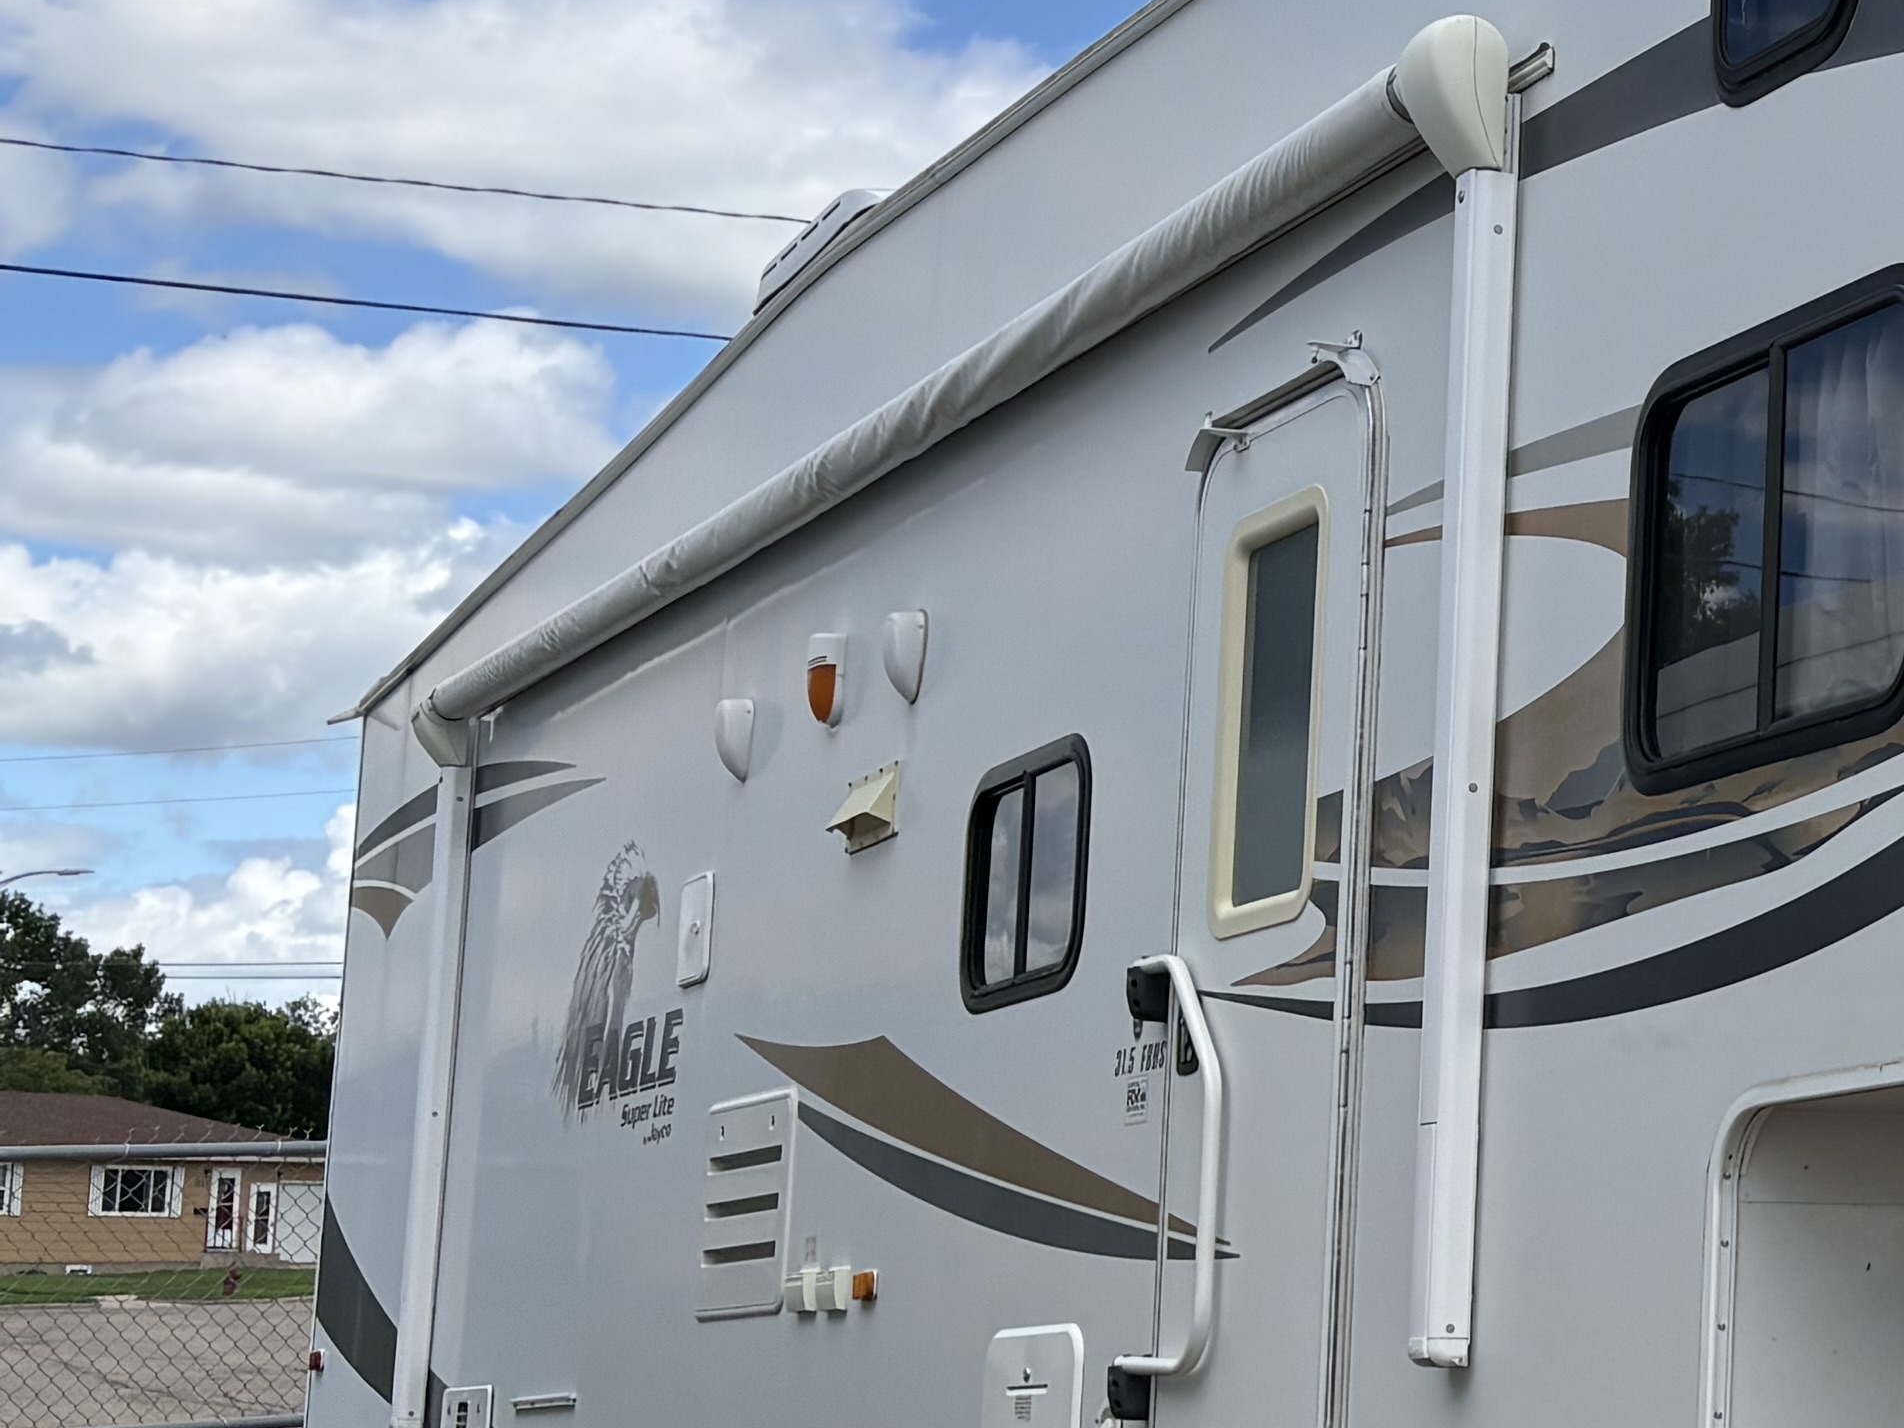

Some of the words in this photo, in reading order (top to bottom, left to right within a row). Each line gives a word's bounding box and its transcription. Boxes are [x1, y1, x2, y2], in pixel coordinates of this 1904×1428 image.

[577, 1007, 683, 1111] EAGLE
[1114, 1046, 1136, 1078] 315
[620, 1103, 652, 1129] Super
[652, 1093, 675, 1118] Lite
